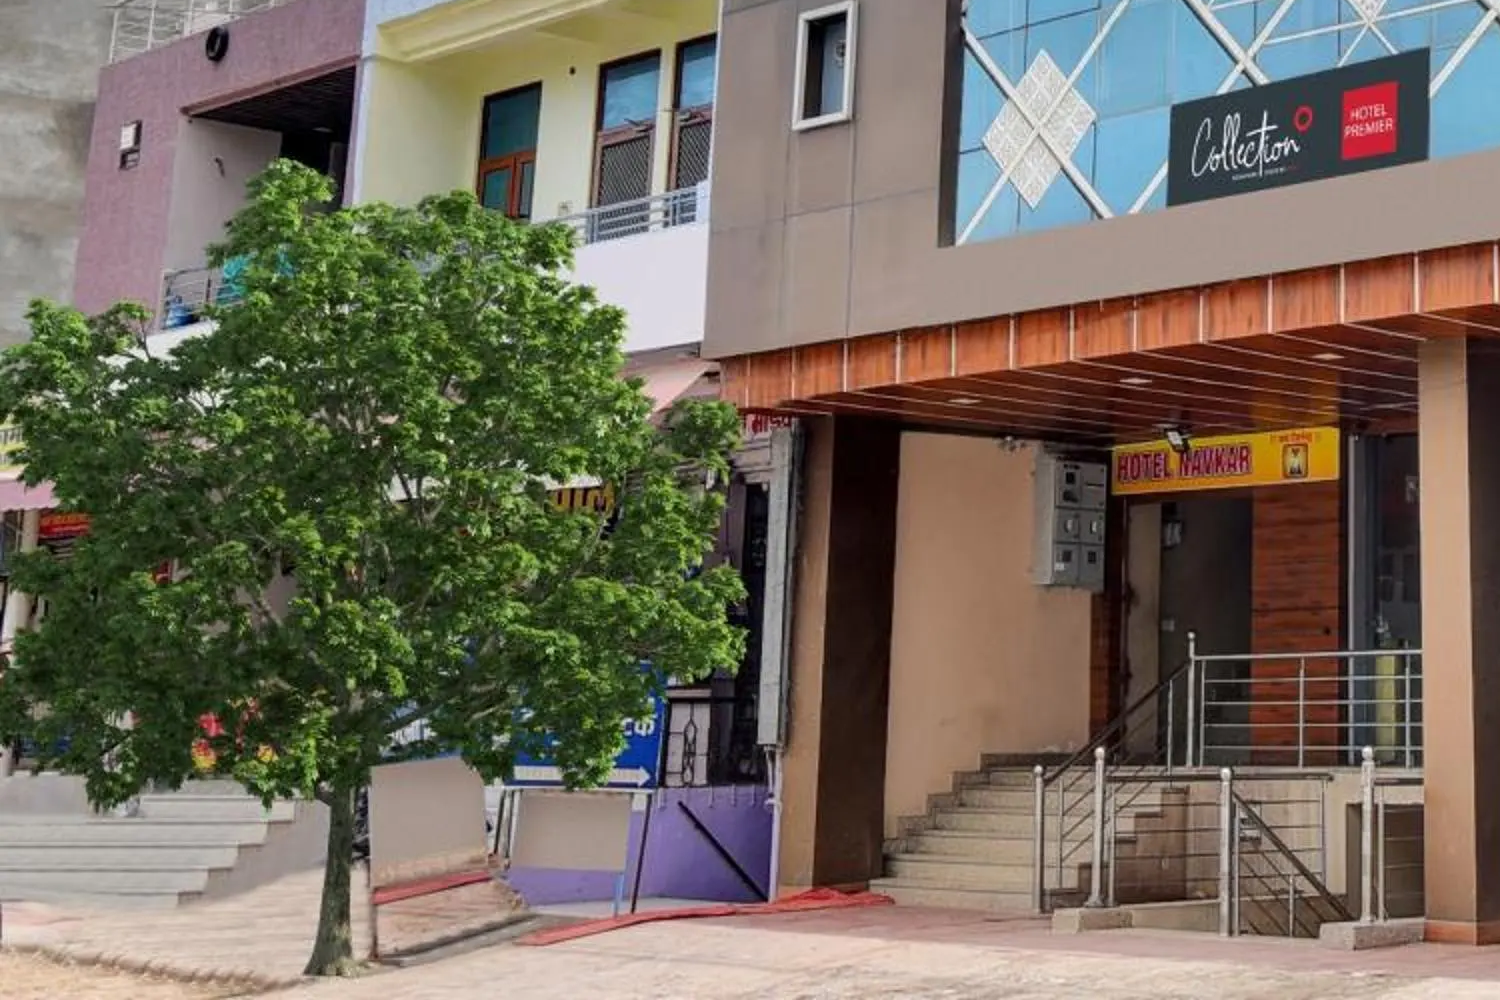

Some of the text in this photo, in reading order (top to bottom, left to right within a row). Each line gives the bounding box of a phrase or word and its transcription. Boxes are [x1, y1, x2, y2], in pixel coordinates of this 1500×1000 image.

[1350, 103, 1388, 121] HOTEL
[1344, 117, 1394, 138] PREMIER
[1191, 110, 1300, 177] Collection
[1117, 444, 1253, 482] HOTEL NAVKAR
